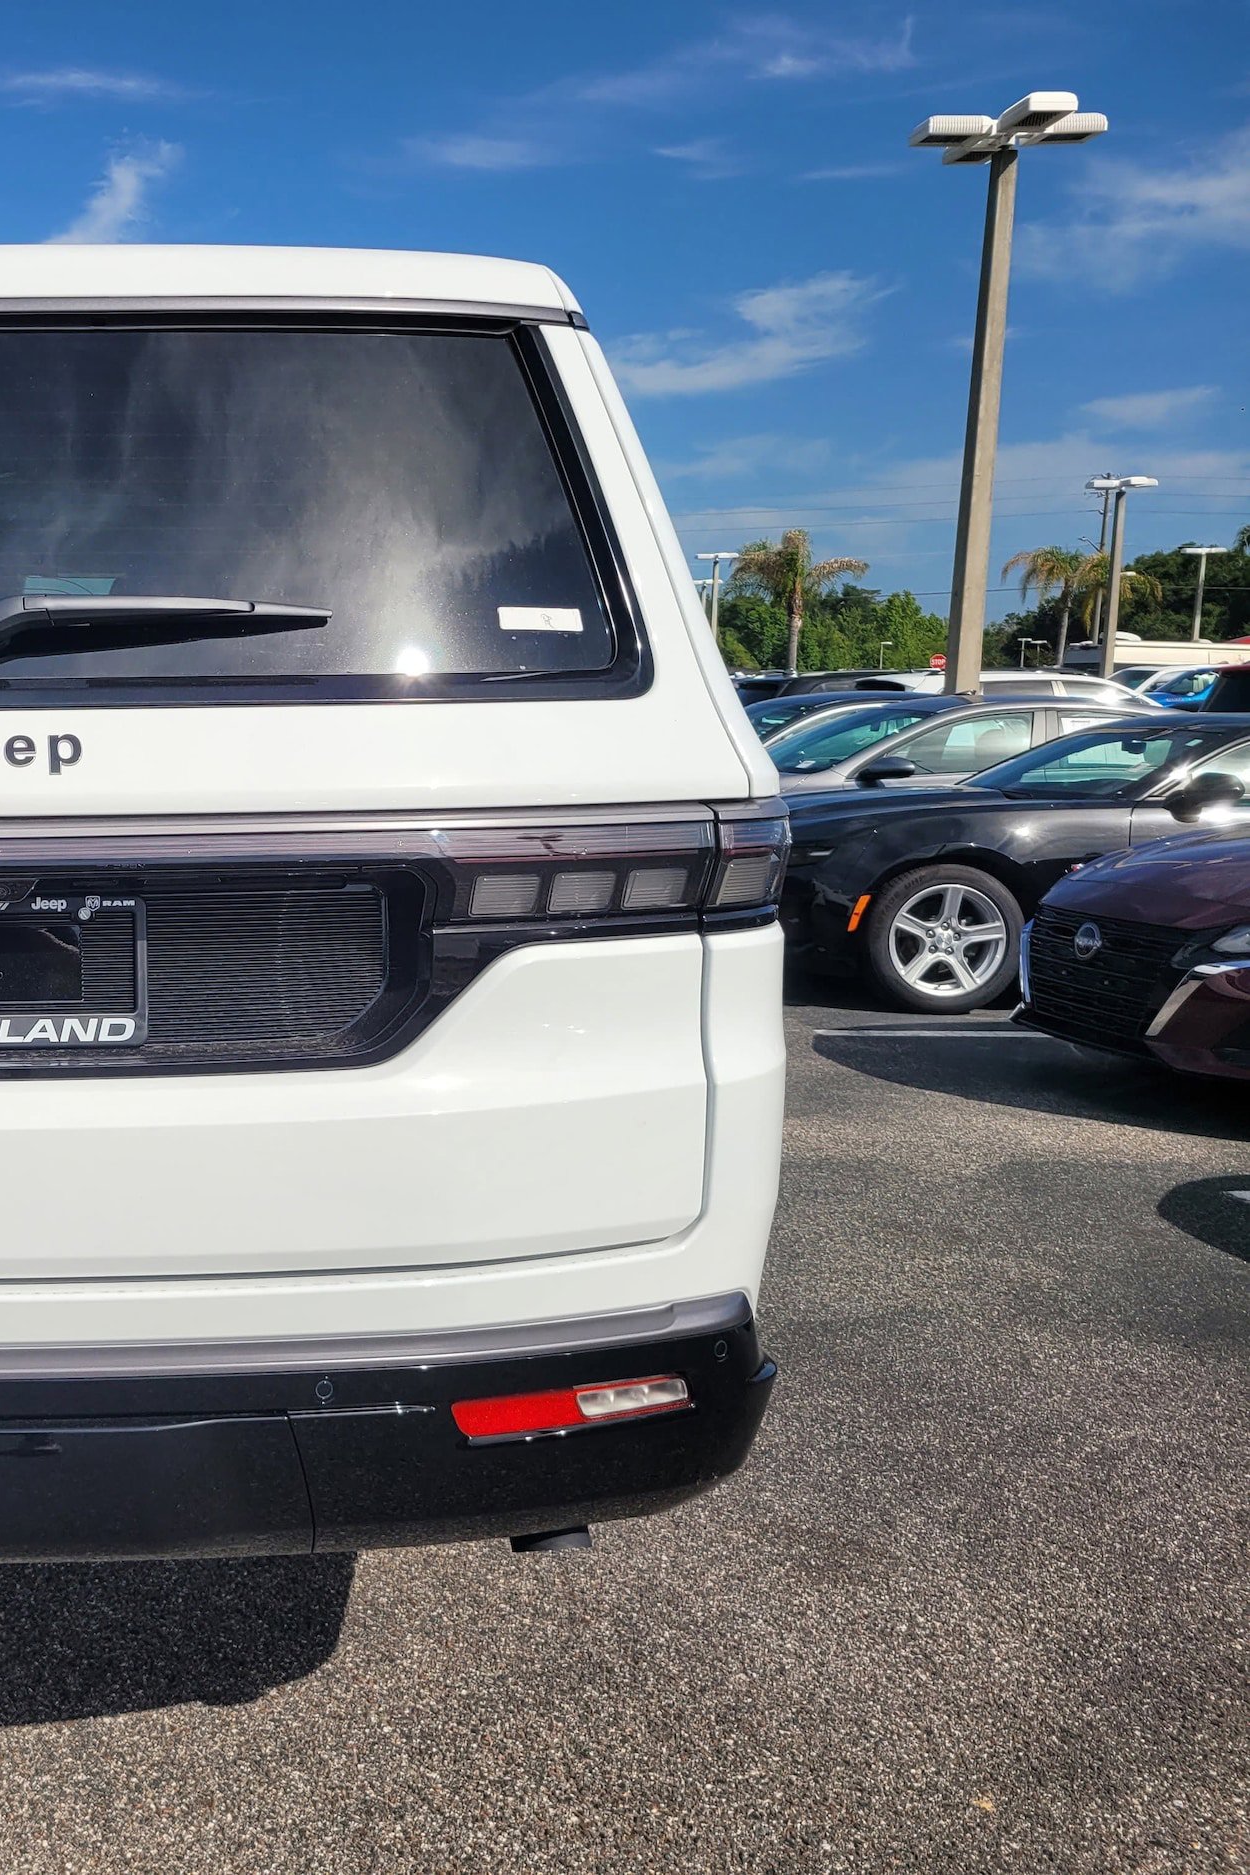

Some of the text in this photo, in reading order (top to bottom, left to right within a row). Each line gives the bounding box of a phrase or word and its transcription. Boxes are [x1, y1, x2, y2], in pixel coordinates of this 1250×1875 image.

[931, 658, 946, 666] STOP
[31, 896, 68, 912] Jeep
[102, 899, 136, 907] RAM
